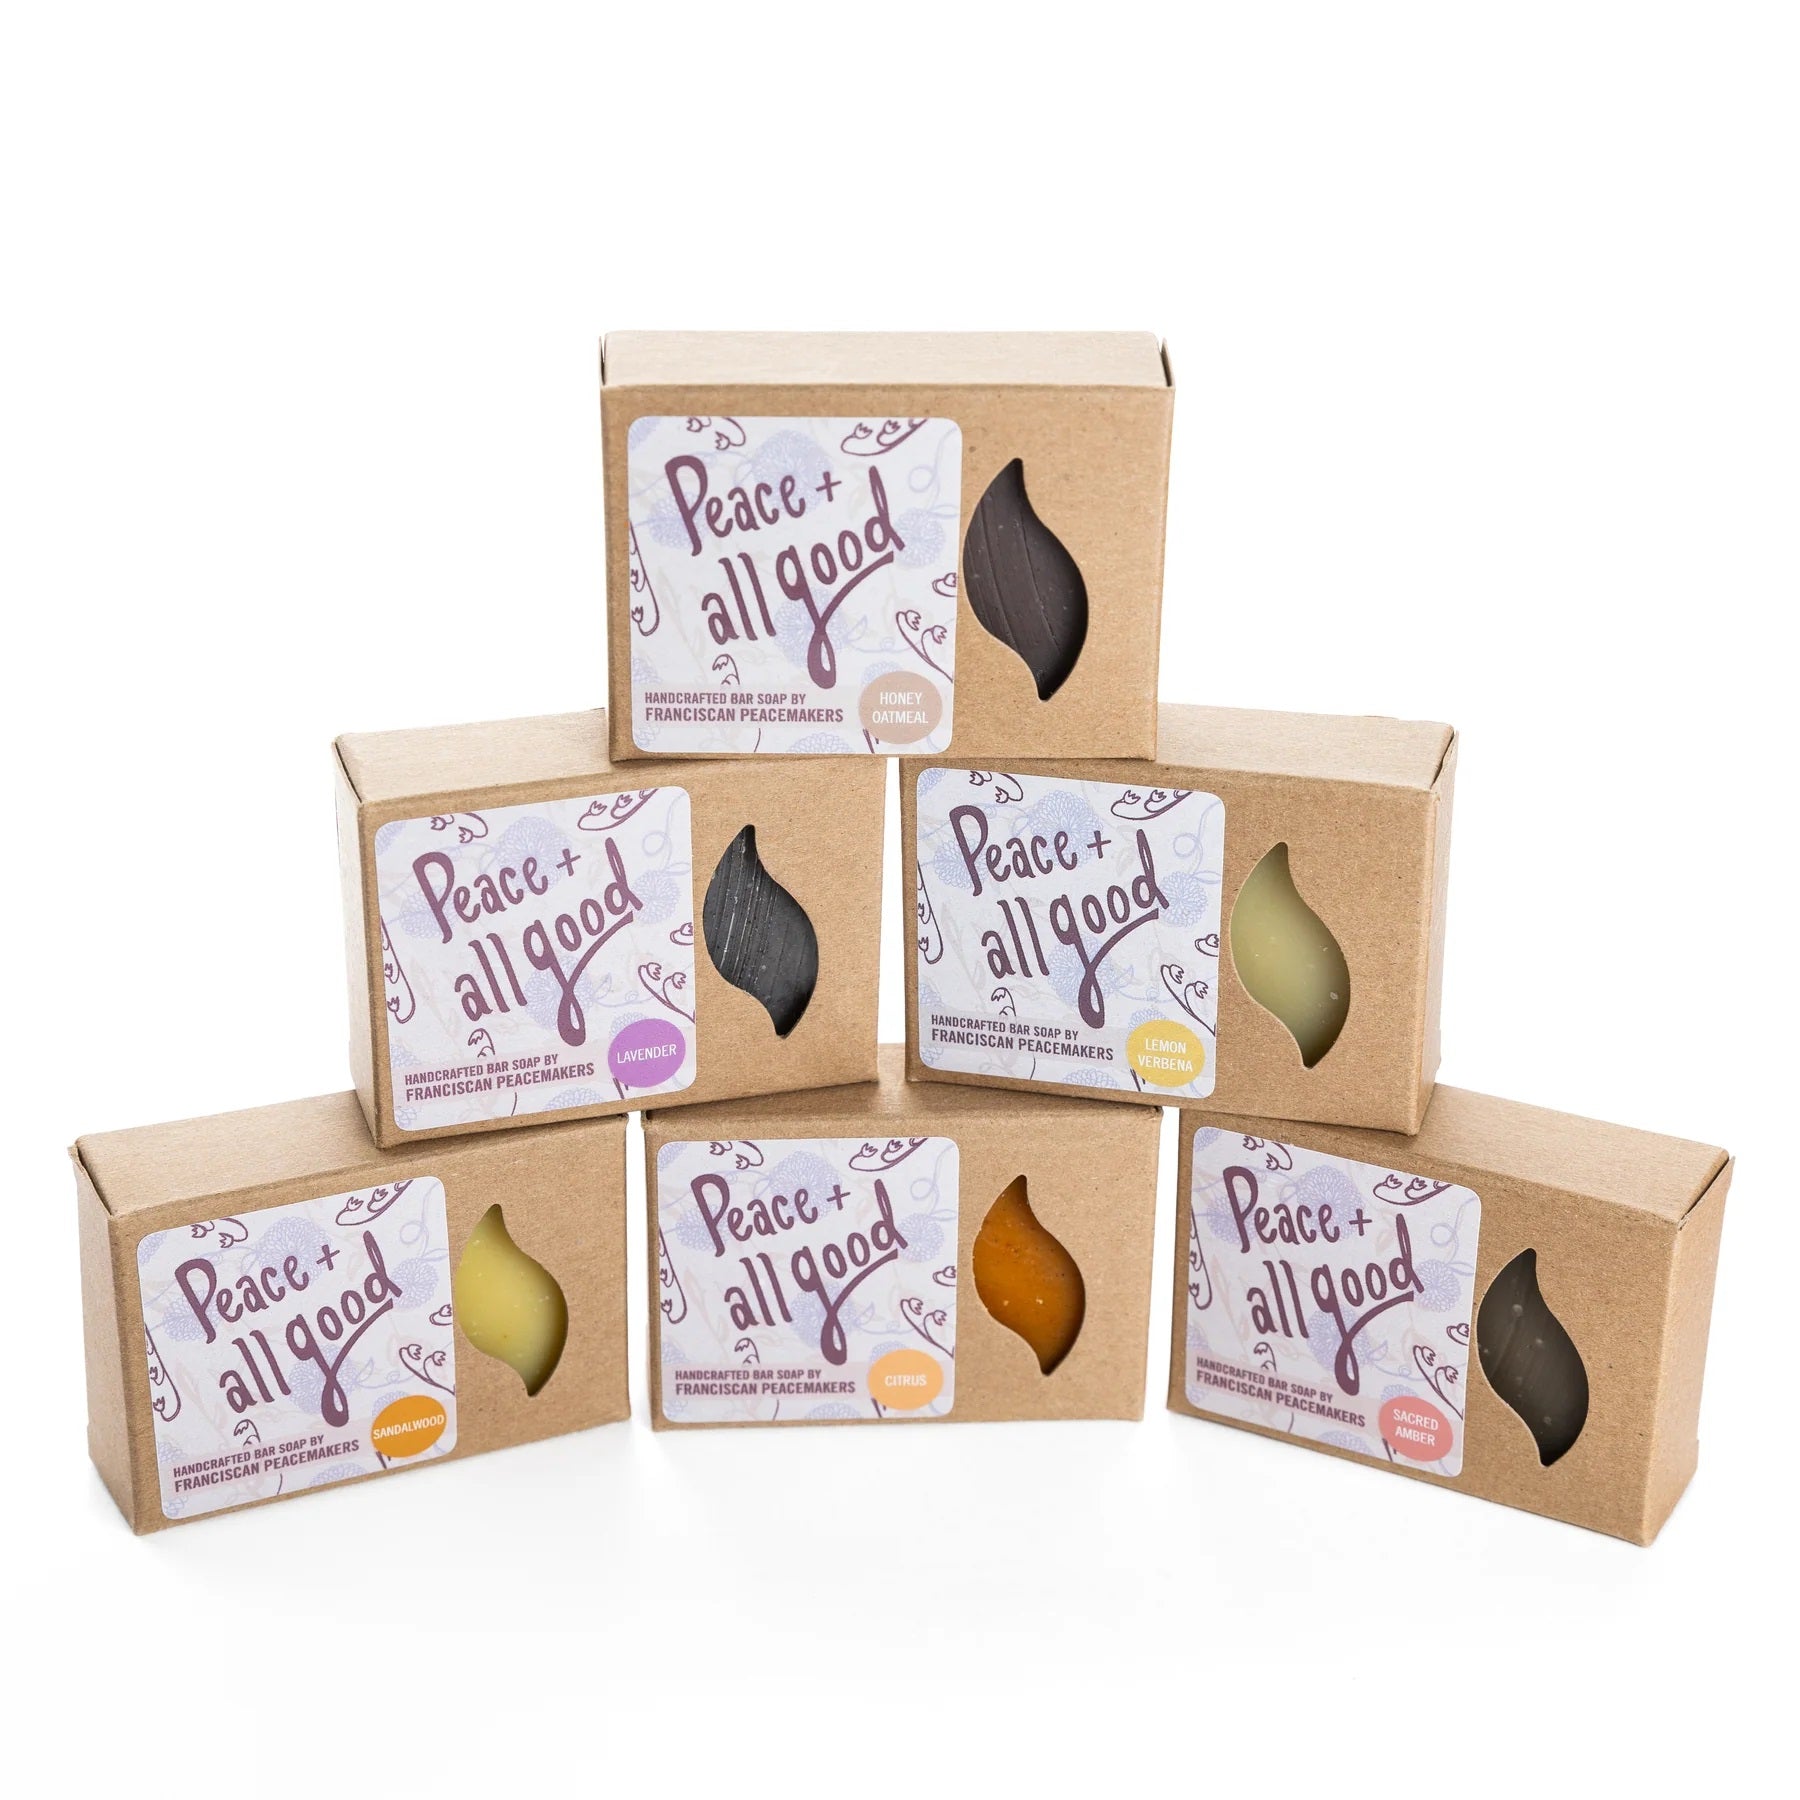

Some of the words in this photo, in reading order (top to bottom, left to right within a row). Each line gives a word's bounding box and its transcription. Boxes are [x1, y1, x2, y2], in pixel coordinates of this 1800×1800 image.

[665, 455, 806, 556] Peace
[702, 553, 776, 645] all
[776, 466, 905, 689] good
[645, 692, 726, 704] HANDCRAFTED
[731, 693, 753, 704] BAR
[758, 694, 787, 704] SOAP
[792, 694, 805, 704] BY
[646, 708, 735, 721] FRANCISCAN
[741, 709, 843, 722] PEACEMAKERS
[872, 710, 928, 724] OATMEAL
[880, 692, 922, 705] HONEY
[948, 803, 1078, 896] Peace
[413, 851, 549, 944] Peace
[455, 933, 527, 1021] all
[523, 837, 643, 1047] good
[982, 897, 1051, 979] all
[1050, 829, 1169, 1029] good
[931, 1014, 1005, 1033] HANDCRAFTED
[1009, 1023, 1030, 1035] BAR
[1034, 1026, 1061, 1038] SOAP
[1065, 1030, 1077, 1040] BY
[932, 1029, 1013, 1049] FRANCISCAN
[1018, 1038, 1113, 1060] PEACEMAKERS
[1145, 1038, 1187, 1054] LEMON
[404, 1065, 483, 1086] HANDCRAFTED
[487, 1061, 509, 1074] BAR
[513, 1057, 541, 1070] SOAP
[545, 1054, 558, 1065] BY
[617, 1044, 677, 1064] LAVENDER
[1138, 1055, 1193, 1072] VERBENA
[406, 1078, 492, 1102] FRANCISCAN
[497, 1062, 594, 1088] PEACEMAKERS
[690, 1173, 818, 1257] Peace
[1223, 1165, 1341, 1253] Peace
[725, 1253, 793, 1331] all
[792, 1179, 908, 1365] good
[174, 1255, 309, 1344] Peace
[1248, 1260, 1310, 1338] all
[1312, 1214, 1425, 1396] good
[219, 1329, 291, 1413] all
[285, 1231, 402, 1427] good
[675, 1370, 749, 1381] HANDCRAFTED
[752, 1370, 773, 1380] BAR
[777, 1370, 804, 1379] SOAP
[808, 1369, 820, 1378] BY
[676, 1383, 757, 1395] FRANCISCAN
[762, 1381, 854, 1394] PEACEMAKERS
[884, 1374, 927, 1387] CITRUS
[1197, 1357, 1265, 1385] HANDCRAFTED
[1268, 1377, 1288, 1391] BAR
[1291, 1383, 1317, 1398] SOAP
[1320, 1391, 1332, 1403] BY
[1197, 1370, 1272, 1401] FRANCISCAN
[1276, 1392, 1364, 1427] PEACEMAKERS
[373, 1414, 445, 1440] SANDALWOOD
[1393, 1408, 1439, 1431] SACRED
[1395, 1426, 1435, 1446] AMBER
[173, 1452, 250, 1477] HANDCRAFTED
[254, 1447, 275, 1460] BAR
[279, 1439, 306, 1454] SOAP
[310, 1435, 322, 1447] BY
[175, 1463, 260, 1492] FRANCISCAN
[264, 1440, 359, 1472] PEACEMAKERS
